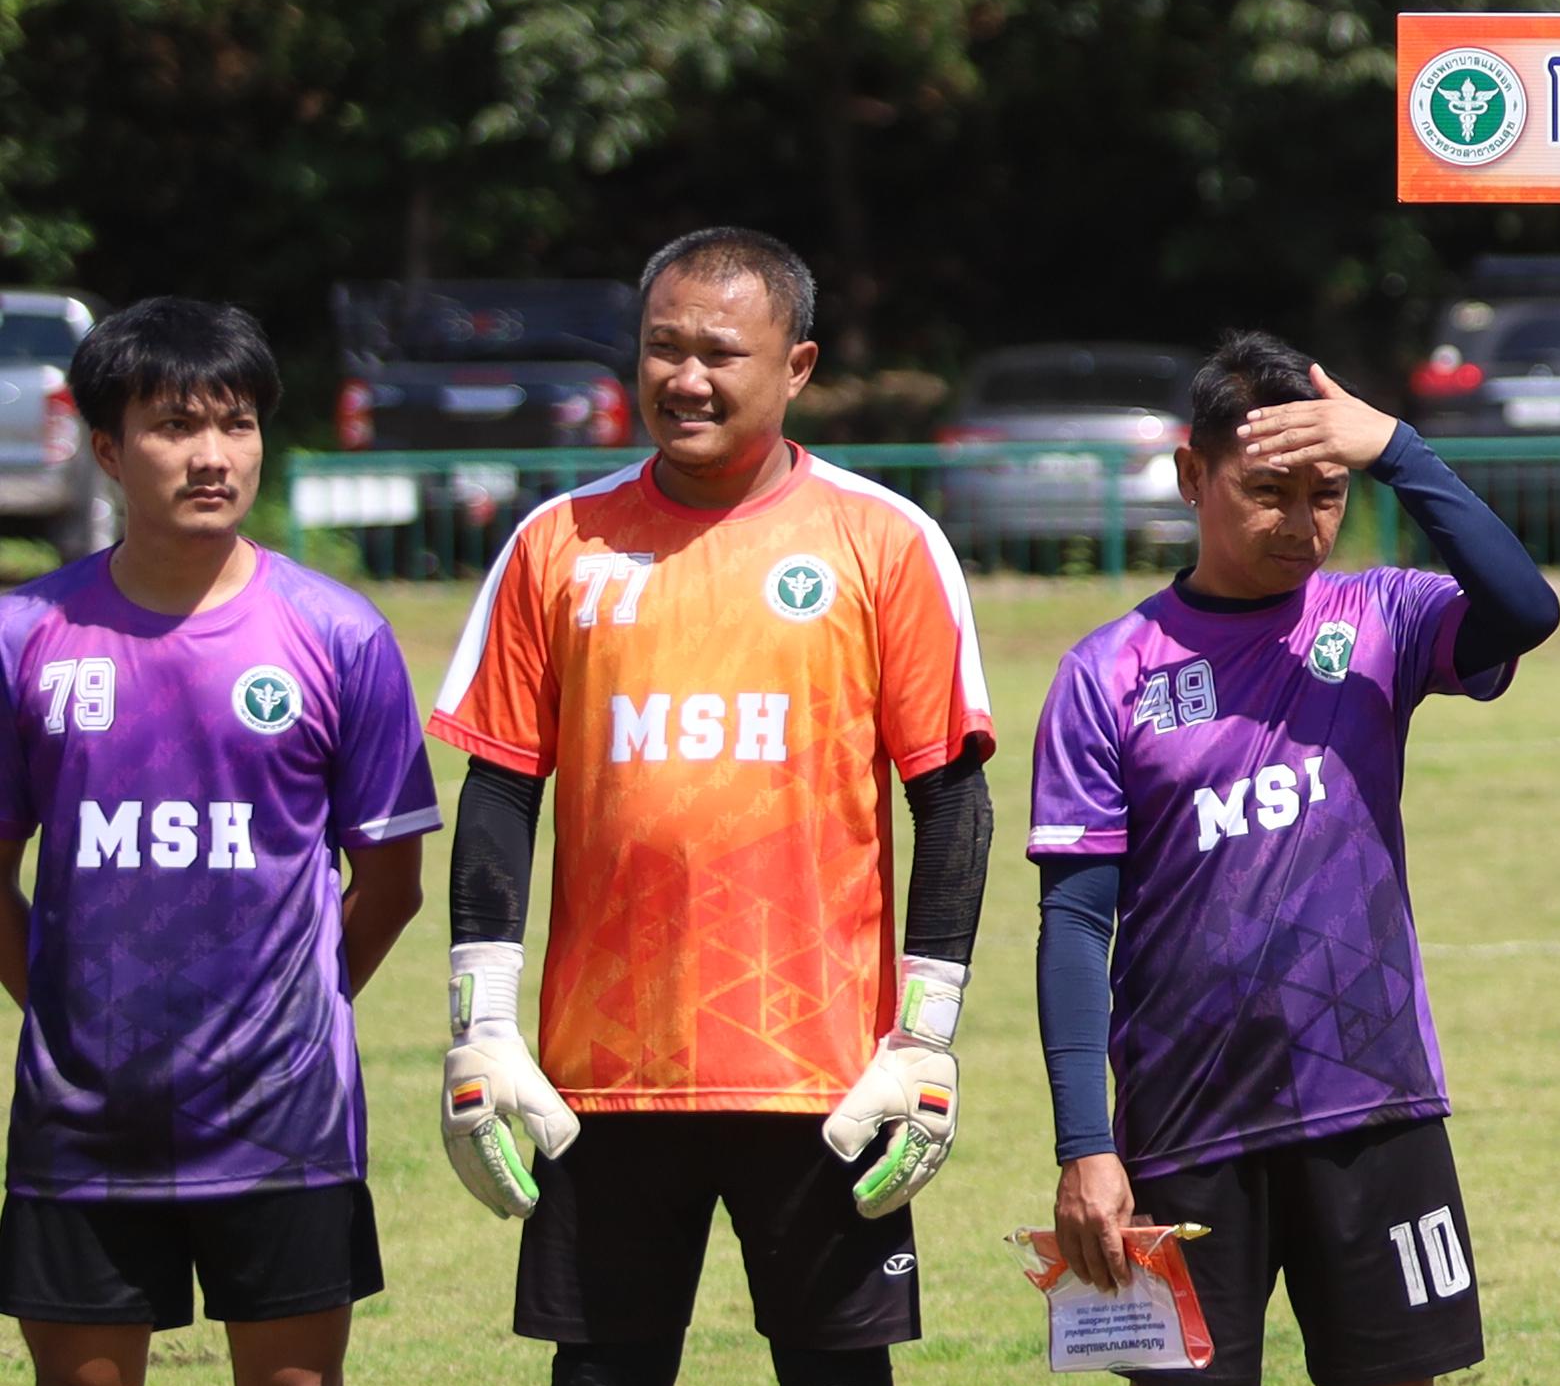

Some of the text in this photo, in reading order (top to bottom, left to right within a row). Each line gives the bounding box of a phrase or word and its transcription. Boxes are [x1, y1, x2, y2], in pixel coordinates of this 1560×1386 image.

[572, 552, 655, 628] 77
[40, 657, 117, 735] 79
[610, 691, 790, 763] MSH
[1132, 659, 1217, 734] 49
[77, 800, 257, 869] MSH
[1387, 1205, 1473, 1308] 10
